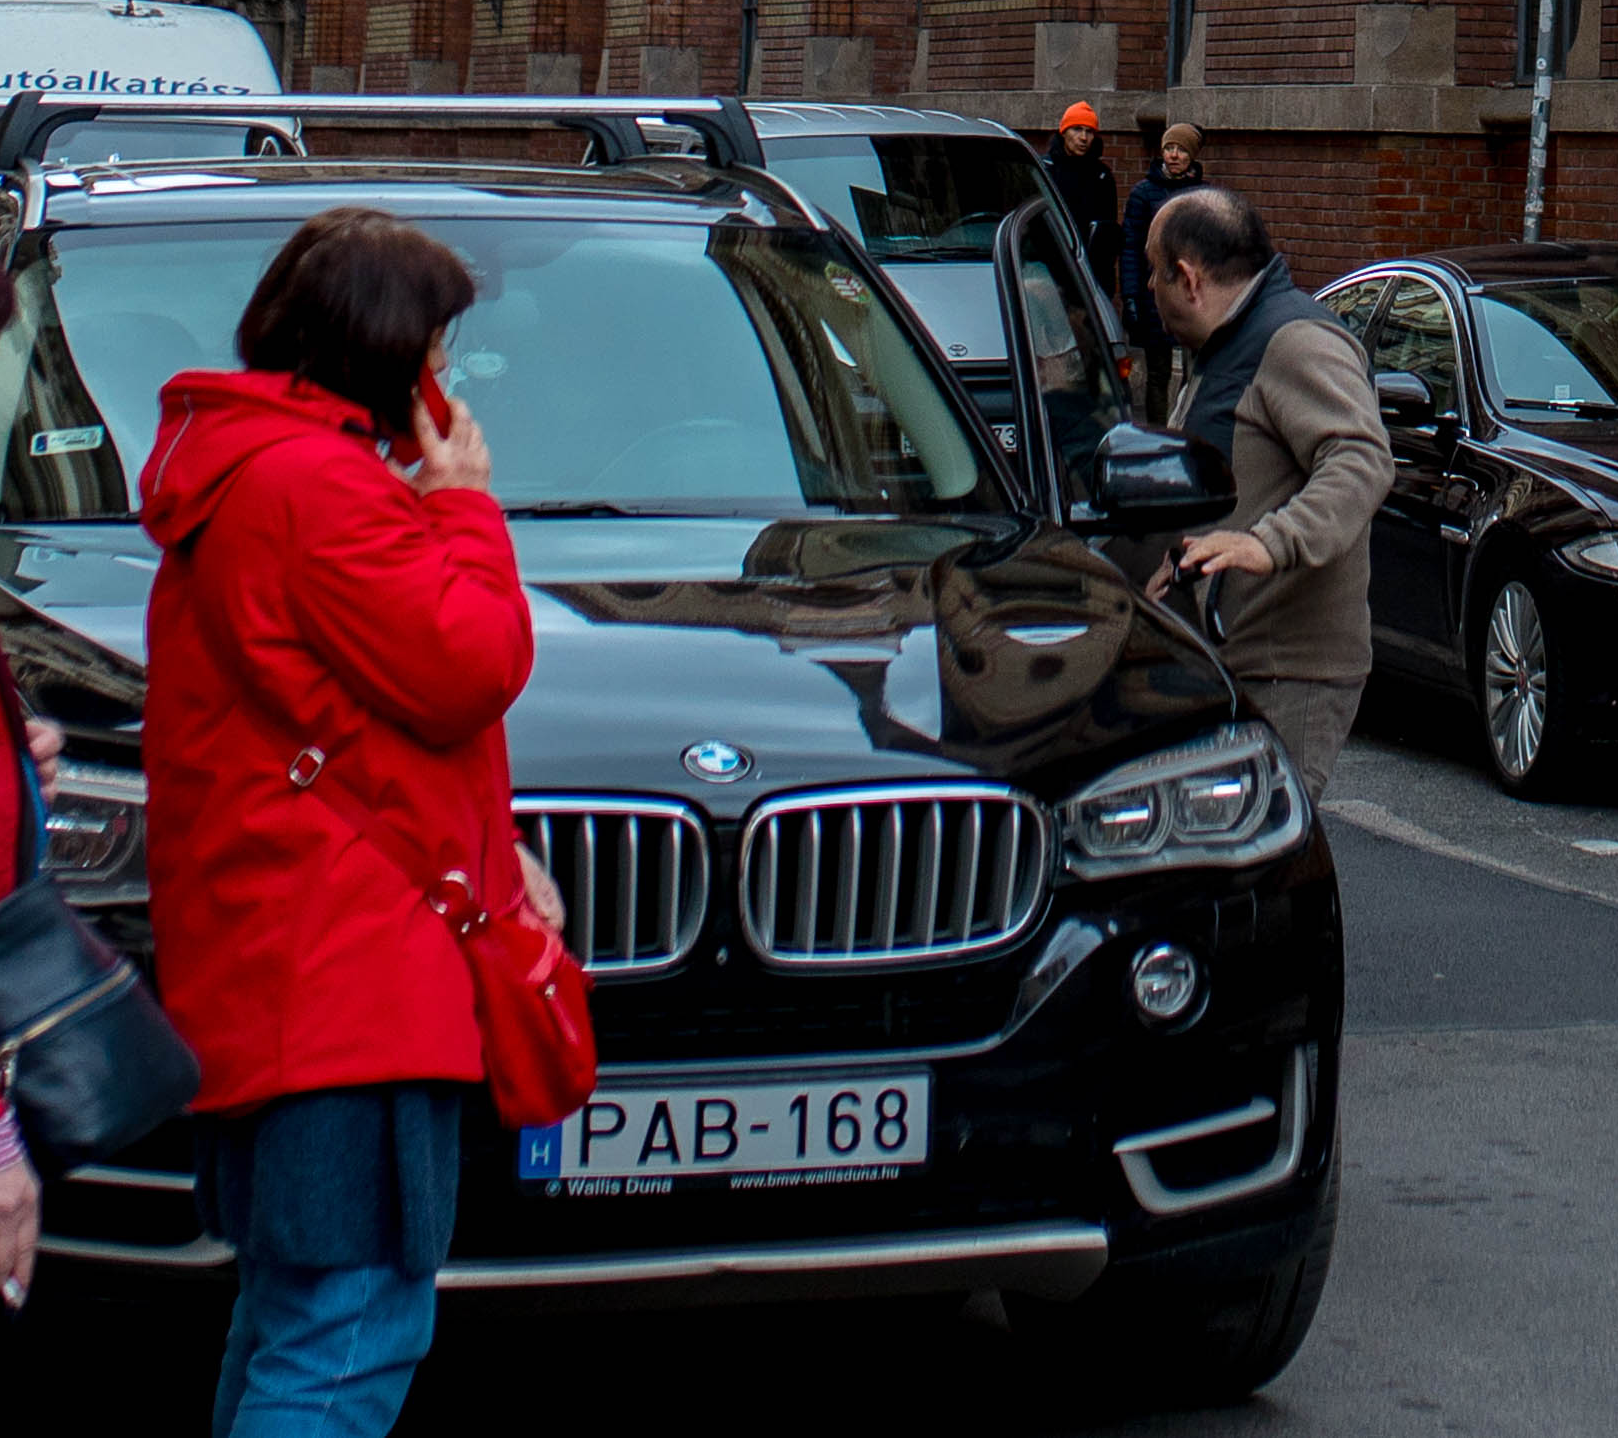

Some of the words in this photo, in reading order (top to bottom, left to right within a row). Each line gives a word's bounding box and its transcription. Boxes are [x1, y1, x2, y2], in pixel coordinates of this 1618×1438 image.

[579, 1087, 909, 1168] PAB-168
[530, 1139, 549, 1166] H
[567, 1177, 621, 1197] Wallis
[626, 1177, 673, 1195] Duna
